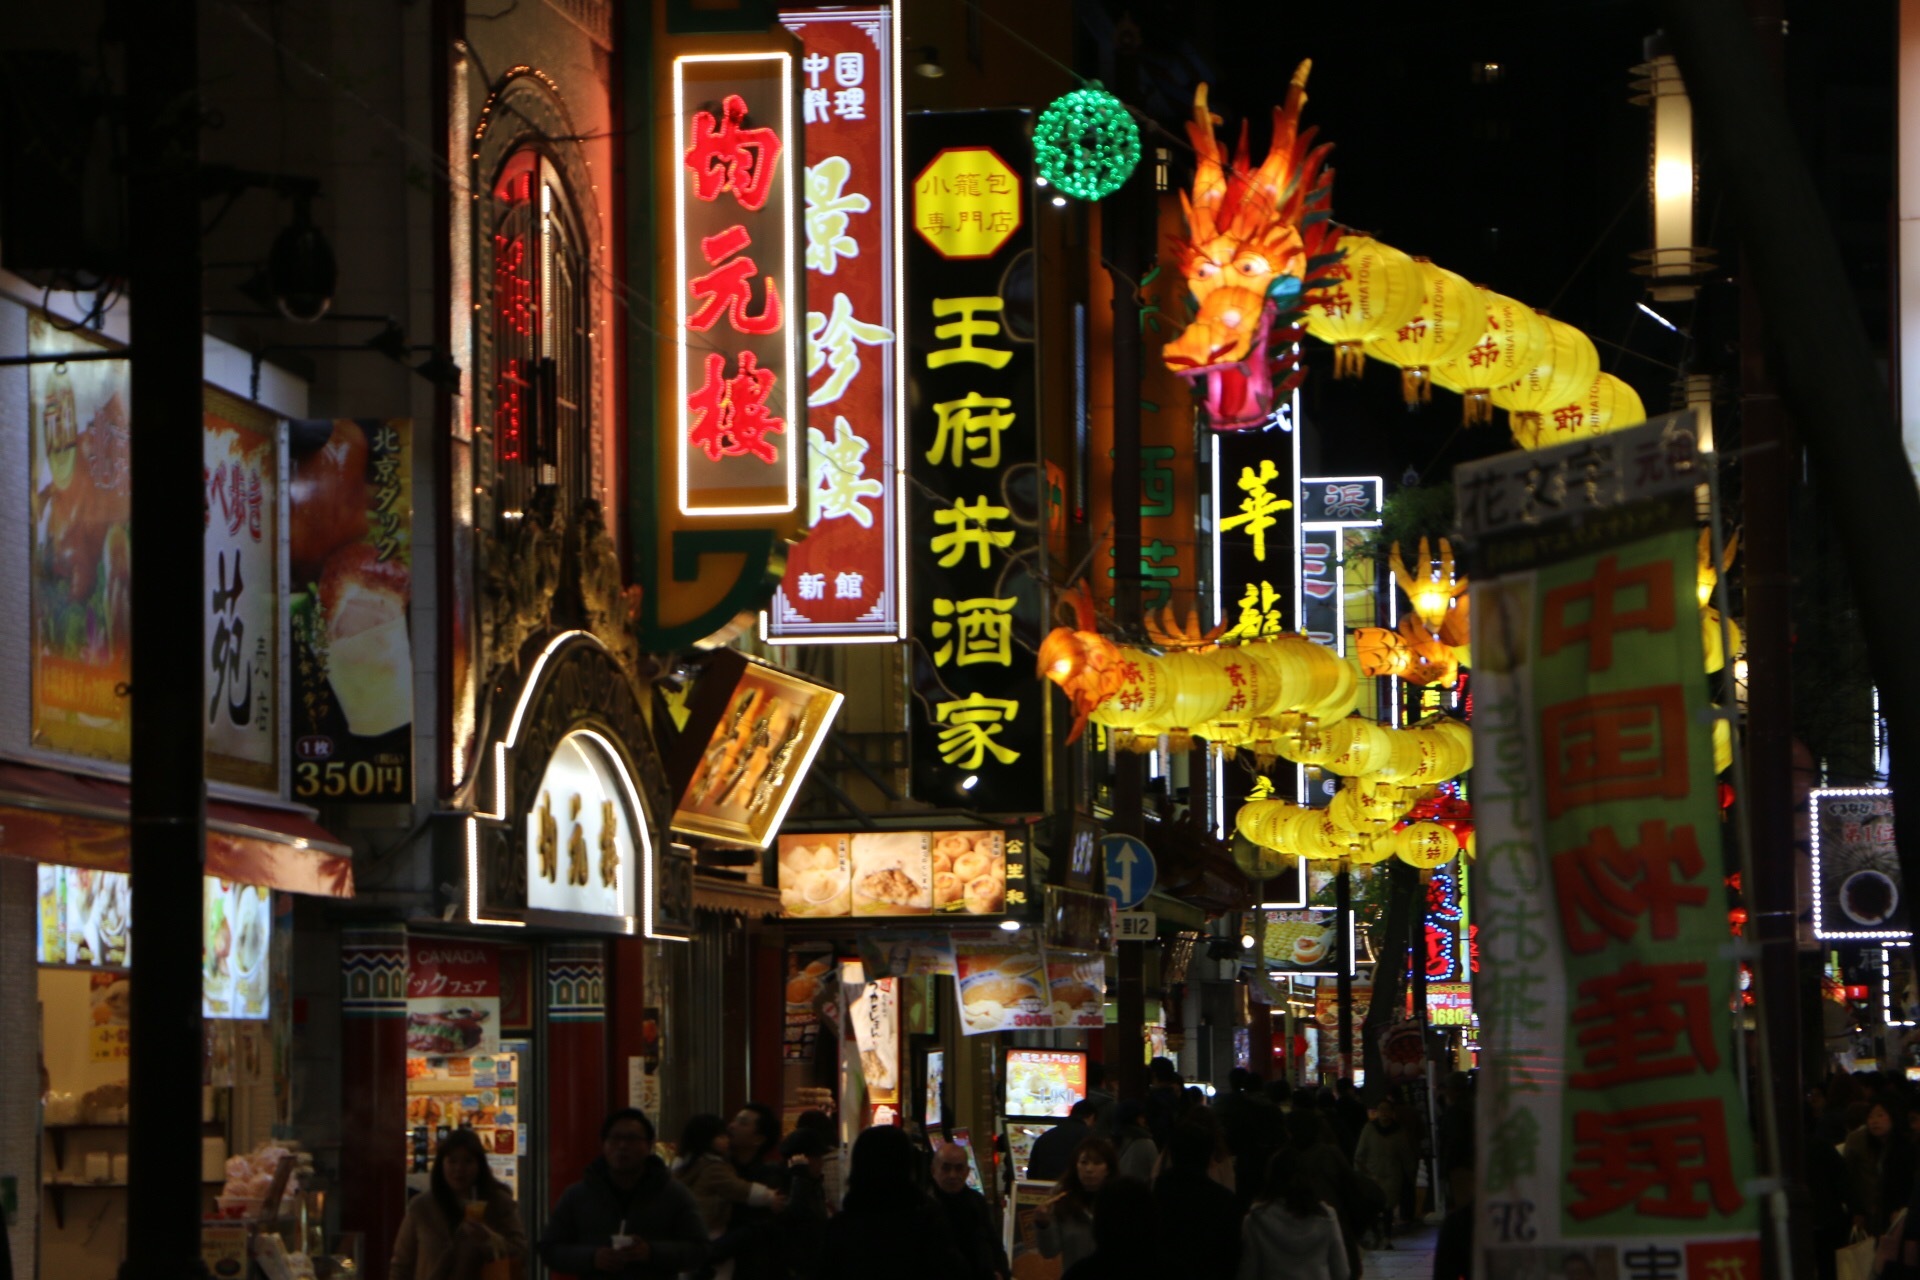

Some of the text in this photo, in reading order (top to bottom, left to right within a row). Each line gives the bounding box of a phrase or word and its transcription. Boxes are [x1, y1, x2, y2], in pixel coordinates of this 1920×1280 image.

[921, 173, 1012, 197] 小籠包
[922, 210, 1014, 236] 専門店
[203, 462, 264, 542] べ歩き
[371, 426, 403, 562] 北京ダック
[926, 294, 1021, 768] 王府井酒家
[797, 571, 864, 601] 新館
[295, 760, 404, 798] 350円
[416, 949, 488, 966] CANADA
